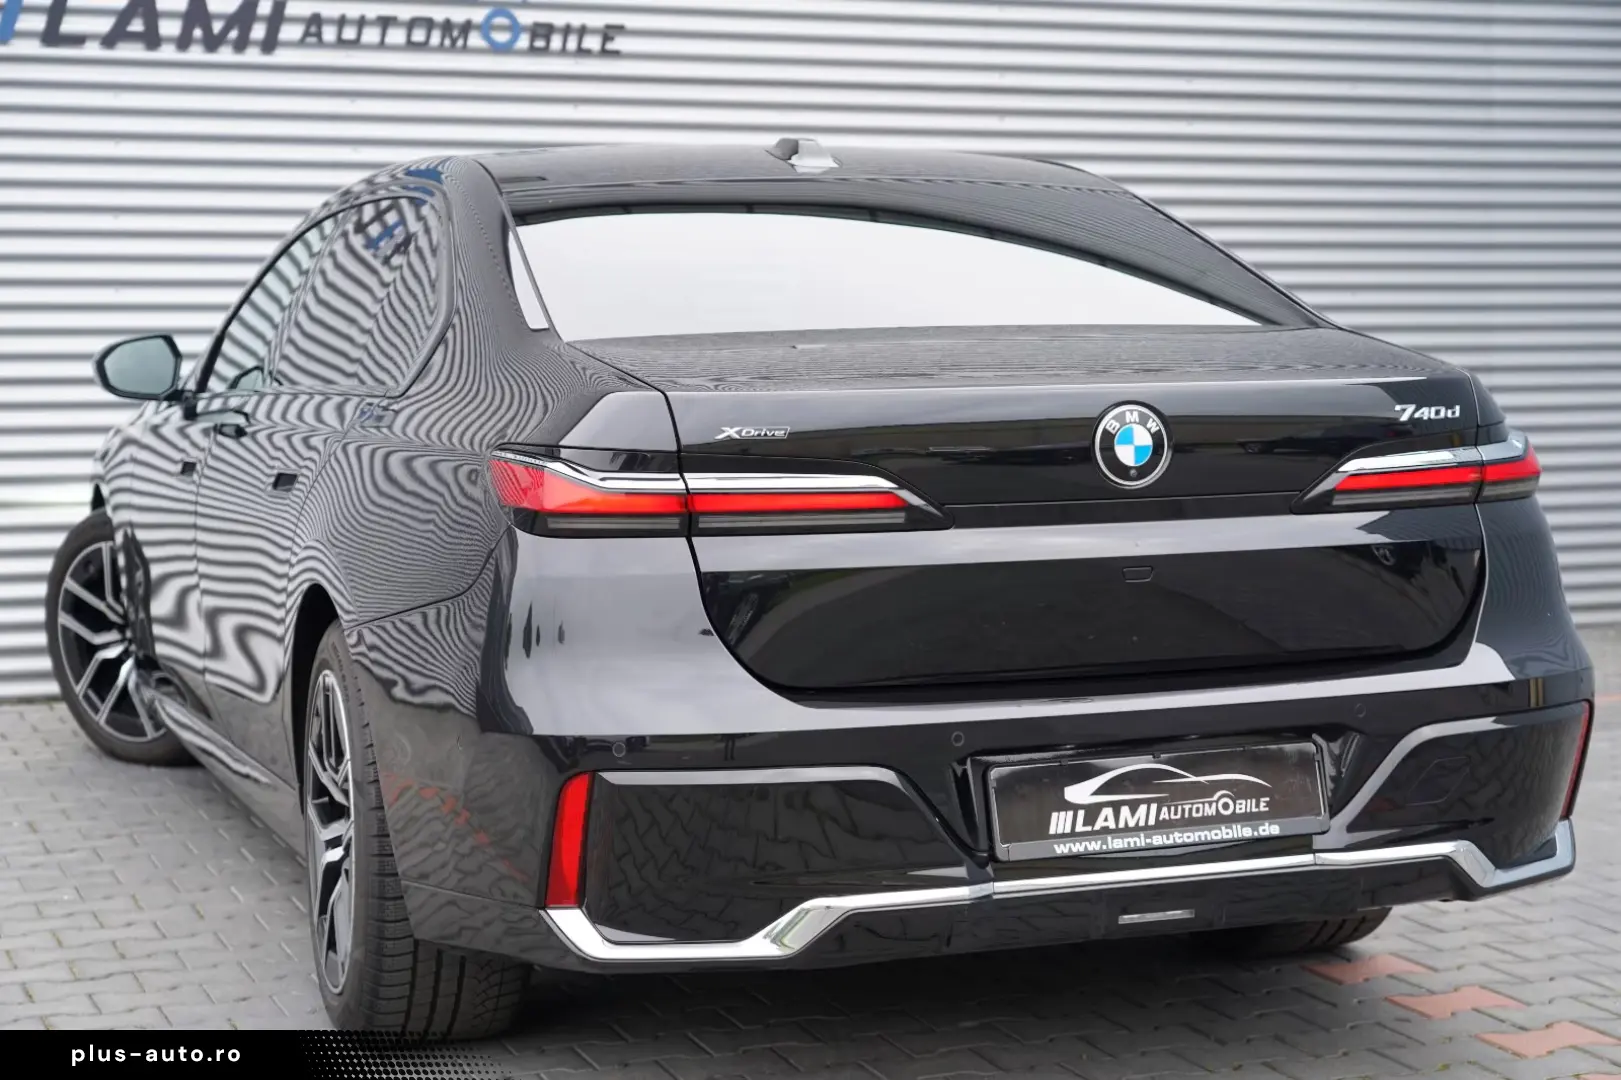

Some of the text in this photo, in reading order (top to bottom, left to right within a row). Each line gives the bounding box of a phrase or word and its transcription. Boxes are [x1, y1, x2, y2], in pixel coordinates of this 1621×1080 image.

[40, 0, 626, 57] LAMI AUTOMOBILE
[1105, 410, 1161, 435] BMW
[1394, 404, 1461, 422] 740d
[1159, 796, 1270, 821] AUTOMOBILE
[1053, 822, 1280, 854] www.lami-automobile.de
